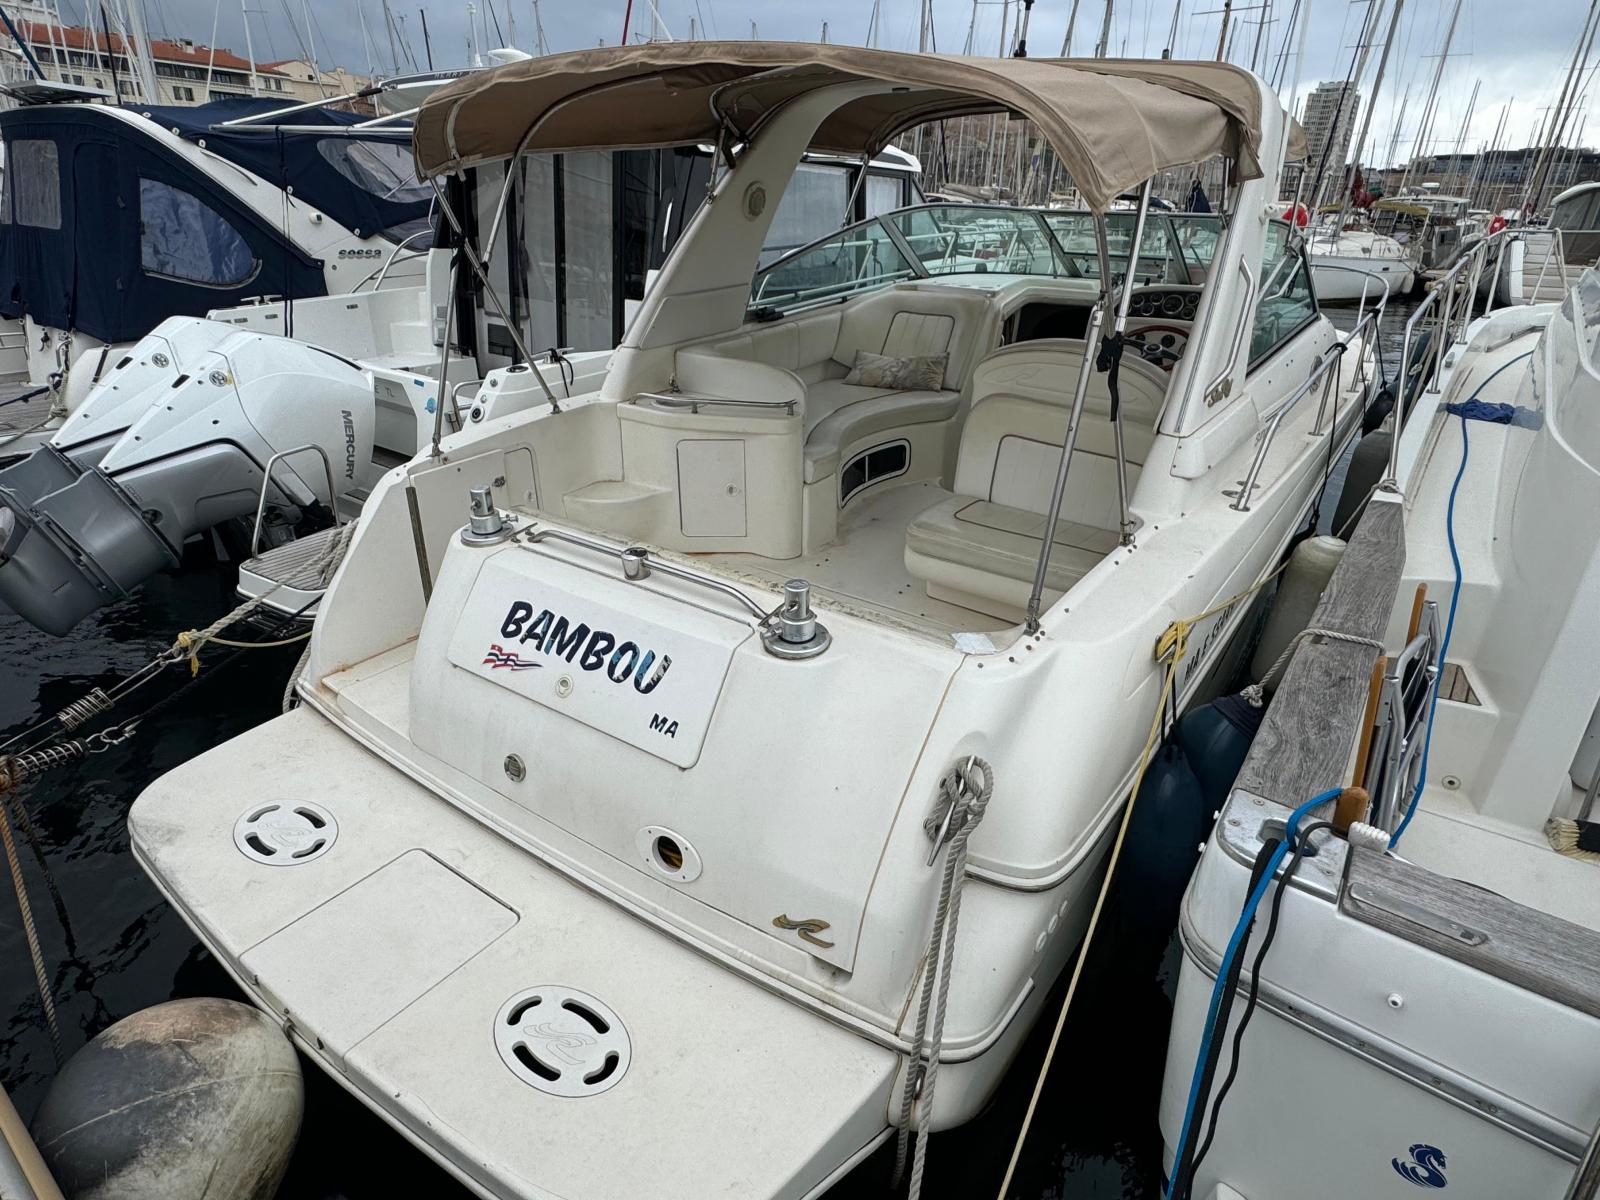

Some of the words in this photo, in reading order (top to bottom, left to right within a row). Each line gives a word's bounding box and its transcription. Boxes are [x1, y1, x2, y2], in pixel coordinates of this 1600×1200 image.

[341, 409, 355, 480] MERCURY
[500, 600, 673, 695] BAMBOU
[649, 713, 679, 739] MA
